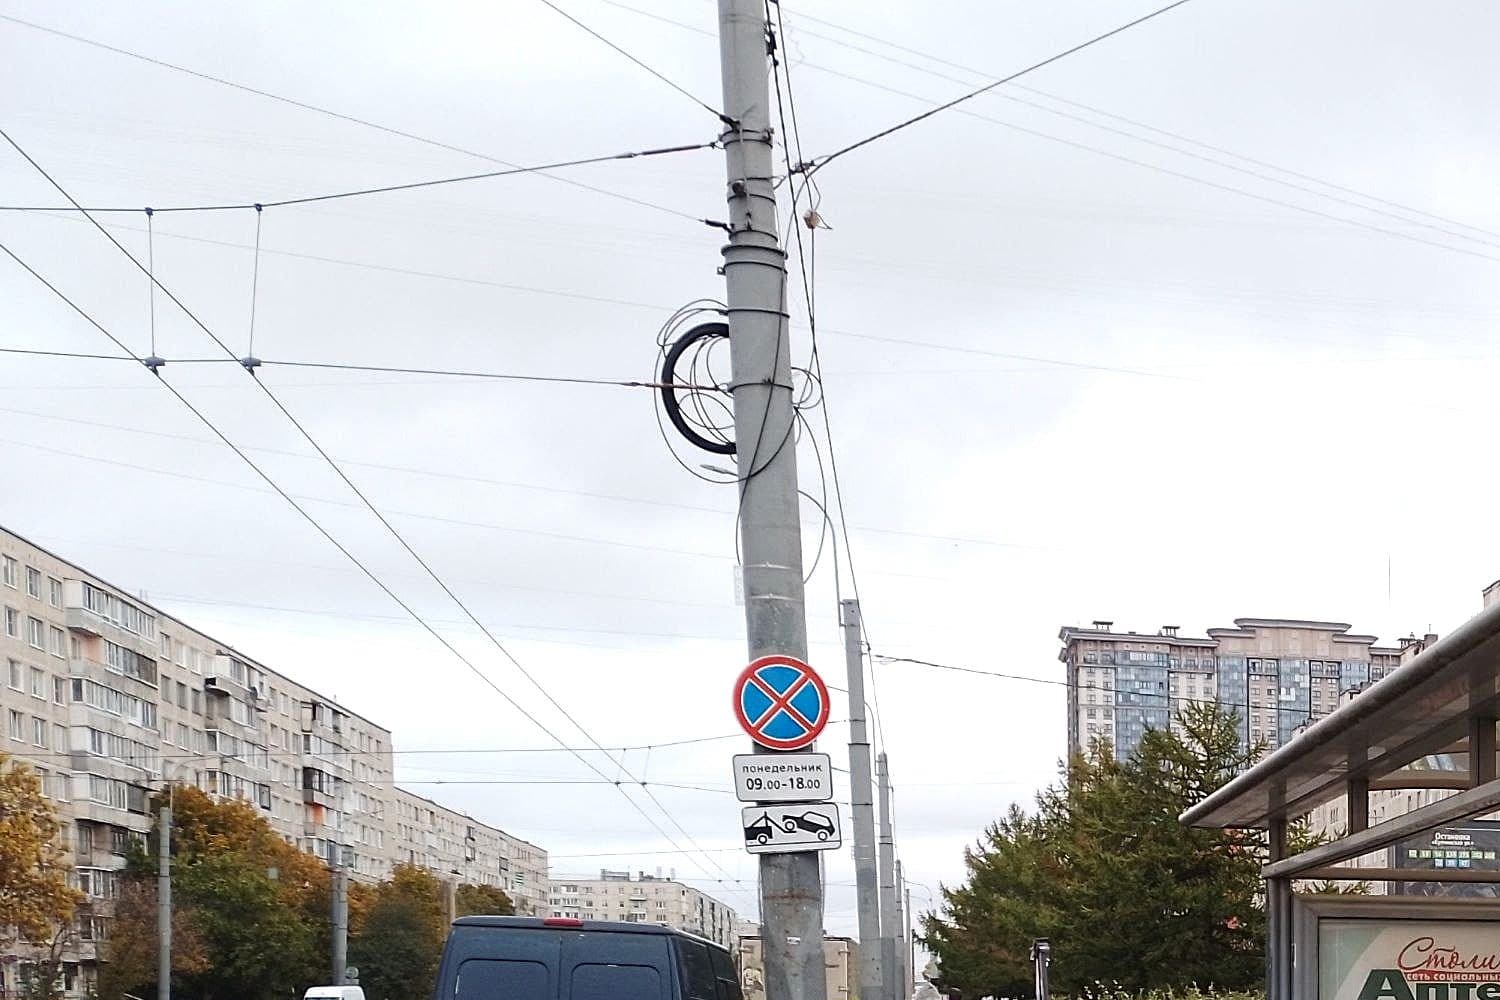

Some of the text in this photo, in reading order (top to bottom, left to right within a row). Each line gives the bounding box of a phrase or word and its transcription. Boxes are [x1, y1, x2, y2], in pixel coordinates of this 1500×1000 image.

[742, 764, 823, 774] понедельник
[746, 777, 821, 790] 09.00-18.00
[1406, 973, 1431, 982] сеть
